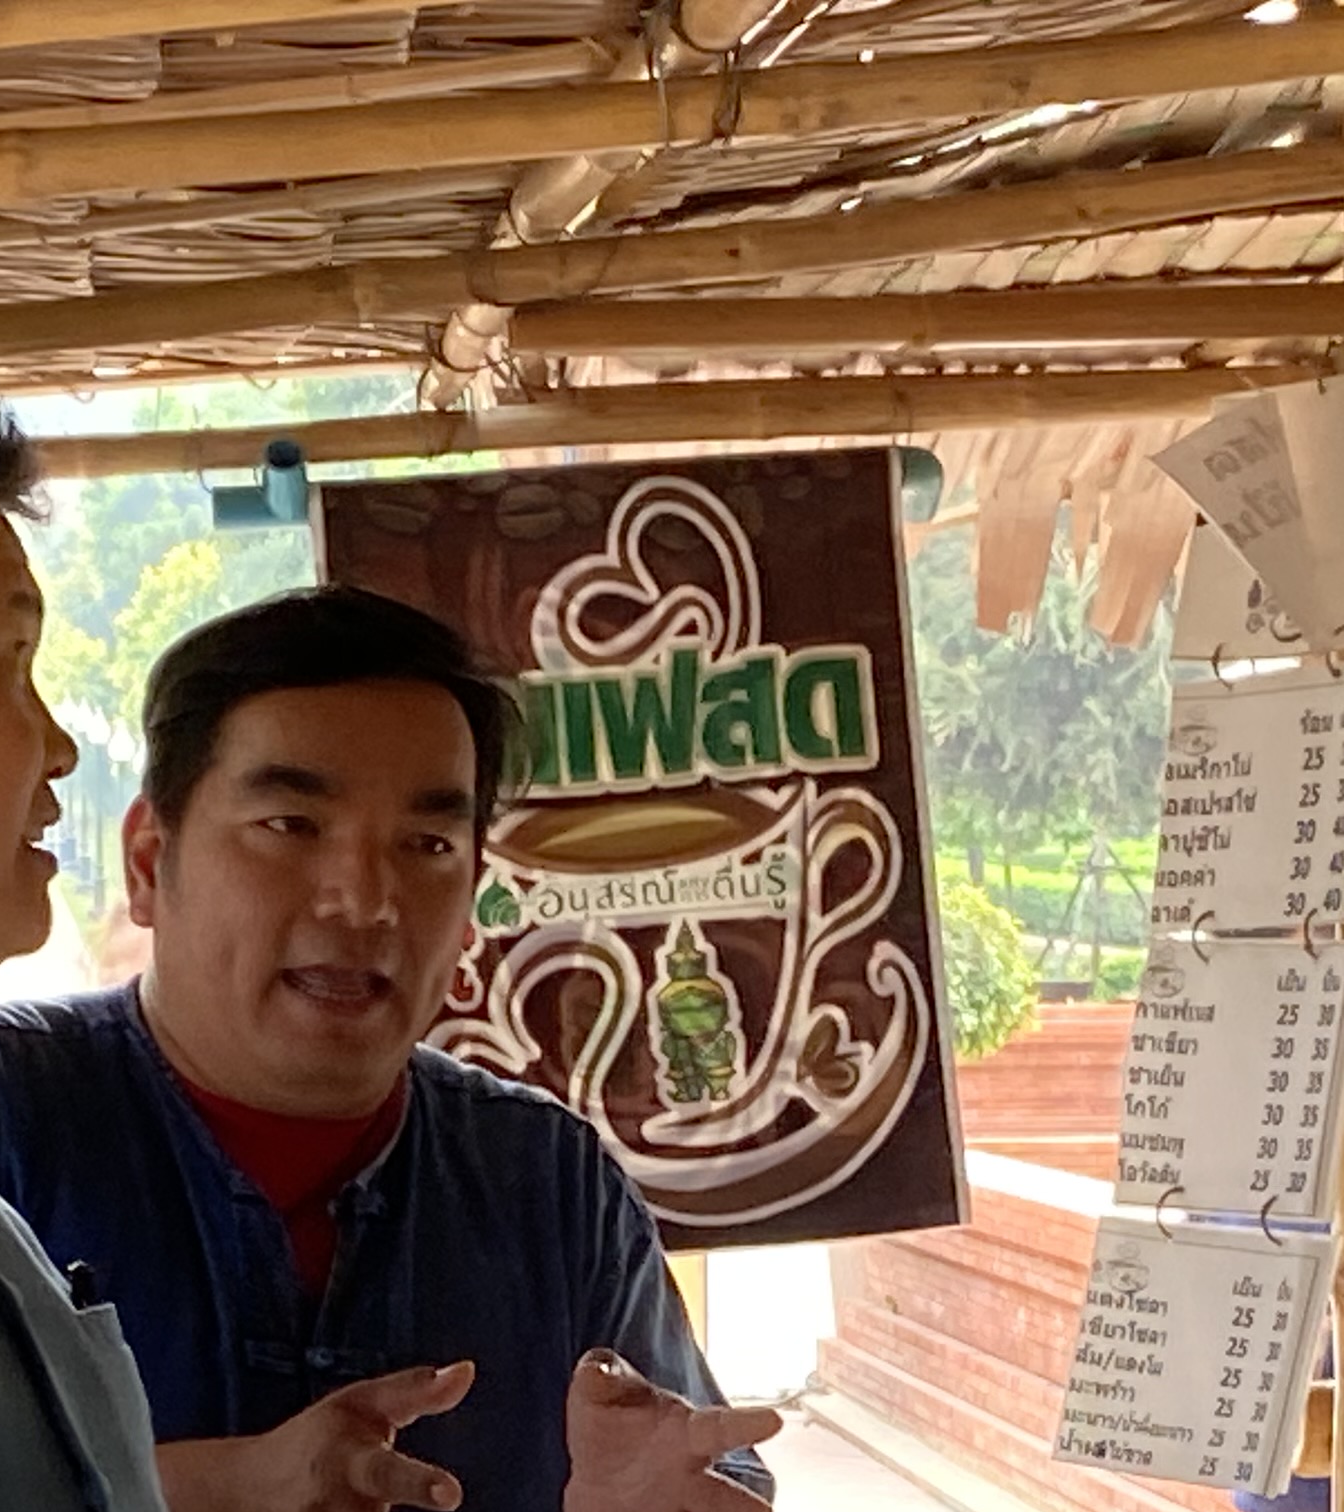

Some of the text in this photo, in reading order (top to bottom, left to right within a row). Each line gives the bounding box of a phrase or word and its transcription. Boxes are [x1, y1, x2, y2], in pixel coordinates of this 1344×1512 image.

[524, 648, 866, 785] แฟสด
[1303, 746, 1325, 771] 25
[1299, 783, 1321, 808] 25
[1293, 819, 1316, 844] 30
[1290, 856, 1311, 880] 30
[1283, 892, 1306, 917] 30
[1276, 1003, 1300, 1026] 25
[1271, 1037, 1294, 1059] 30
[1266, 1070, 1289, 1092] 30
[1261, 1104, 1284, 1126] 30
[1256, 1136, 1278, 1159] 30
[1250, 1170, 1270, 1192] 25
[1232, 1306, 1255, 1329] 25
[1225, 1337, 1250, 1358] 25
[1220, 1367, 1244, 1389] 25
[1214, 1397, 1236, 1418] 25
[1208, 1429, 1227, 1448] 25
[1198, 1455, 1219, 1477] 25
